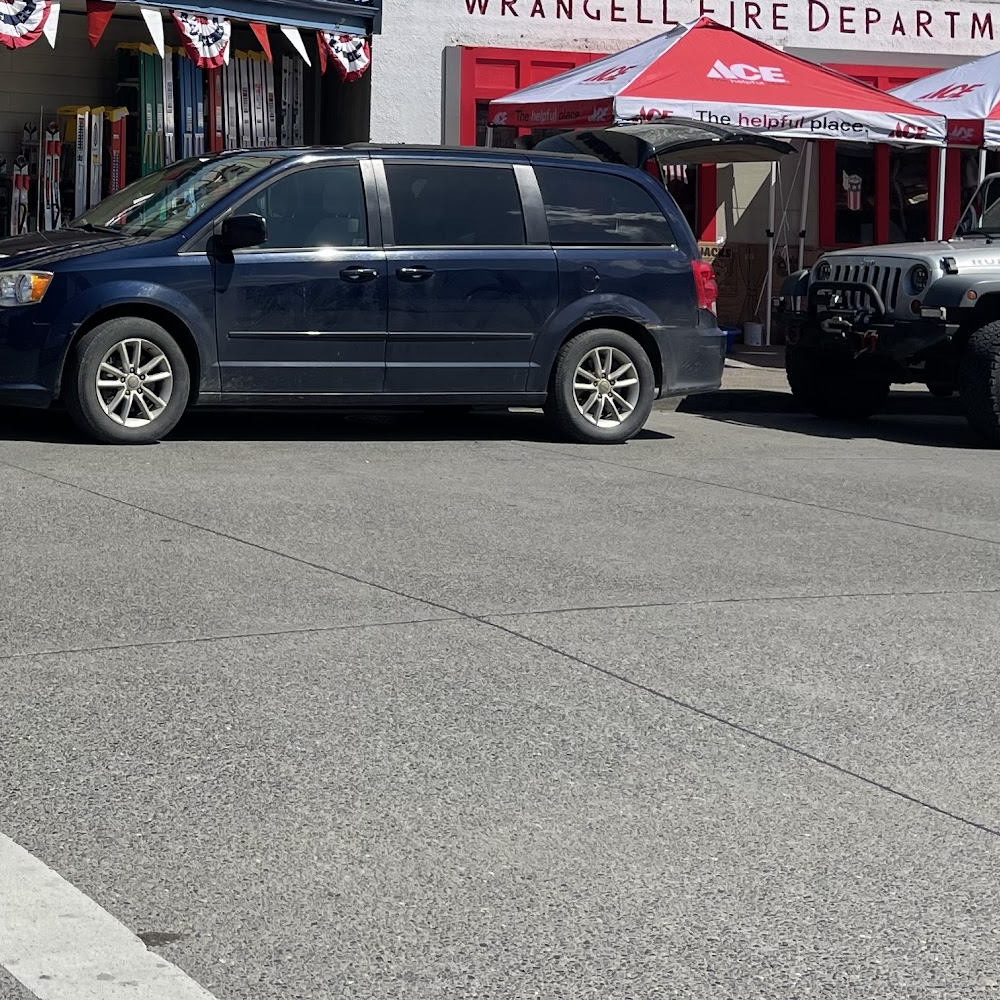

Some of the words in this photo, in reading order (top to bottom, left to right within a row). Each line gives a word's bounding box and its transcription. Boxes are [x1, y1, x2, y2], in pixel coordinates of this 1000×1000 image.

[582, 65, 638, 82] ACE
[706, 59, 787, 83] ACE
[916, 83, 985, 99] ACE
[515, 110, 530, 121] The
[531, 108, 558, 124] helpful
[638, 106, 673, 122] ACE
[696, 110, 731, 126] The
[738, 113, 805, 130] helpful
[811, 117, 869, 133] place.
[887, 121, 928, 140] ACE
[951, 125, 975, 139] ACE
